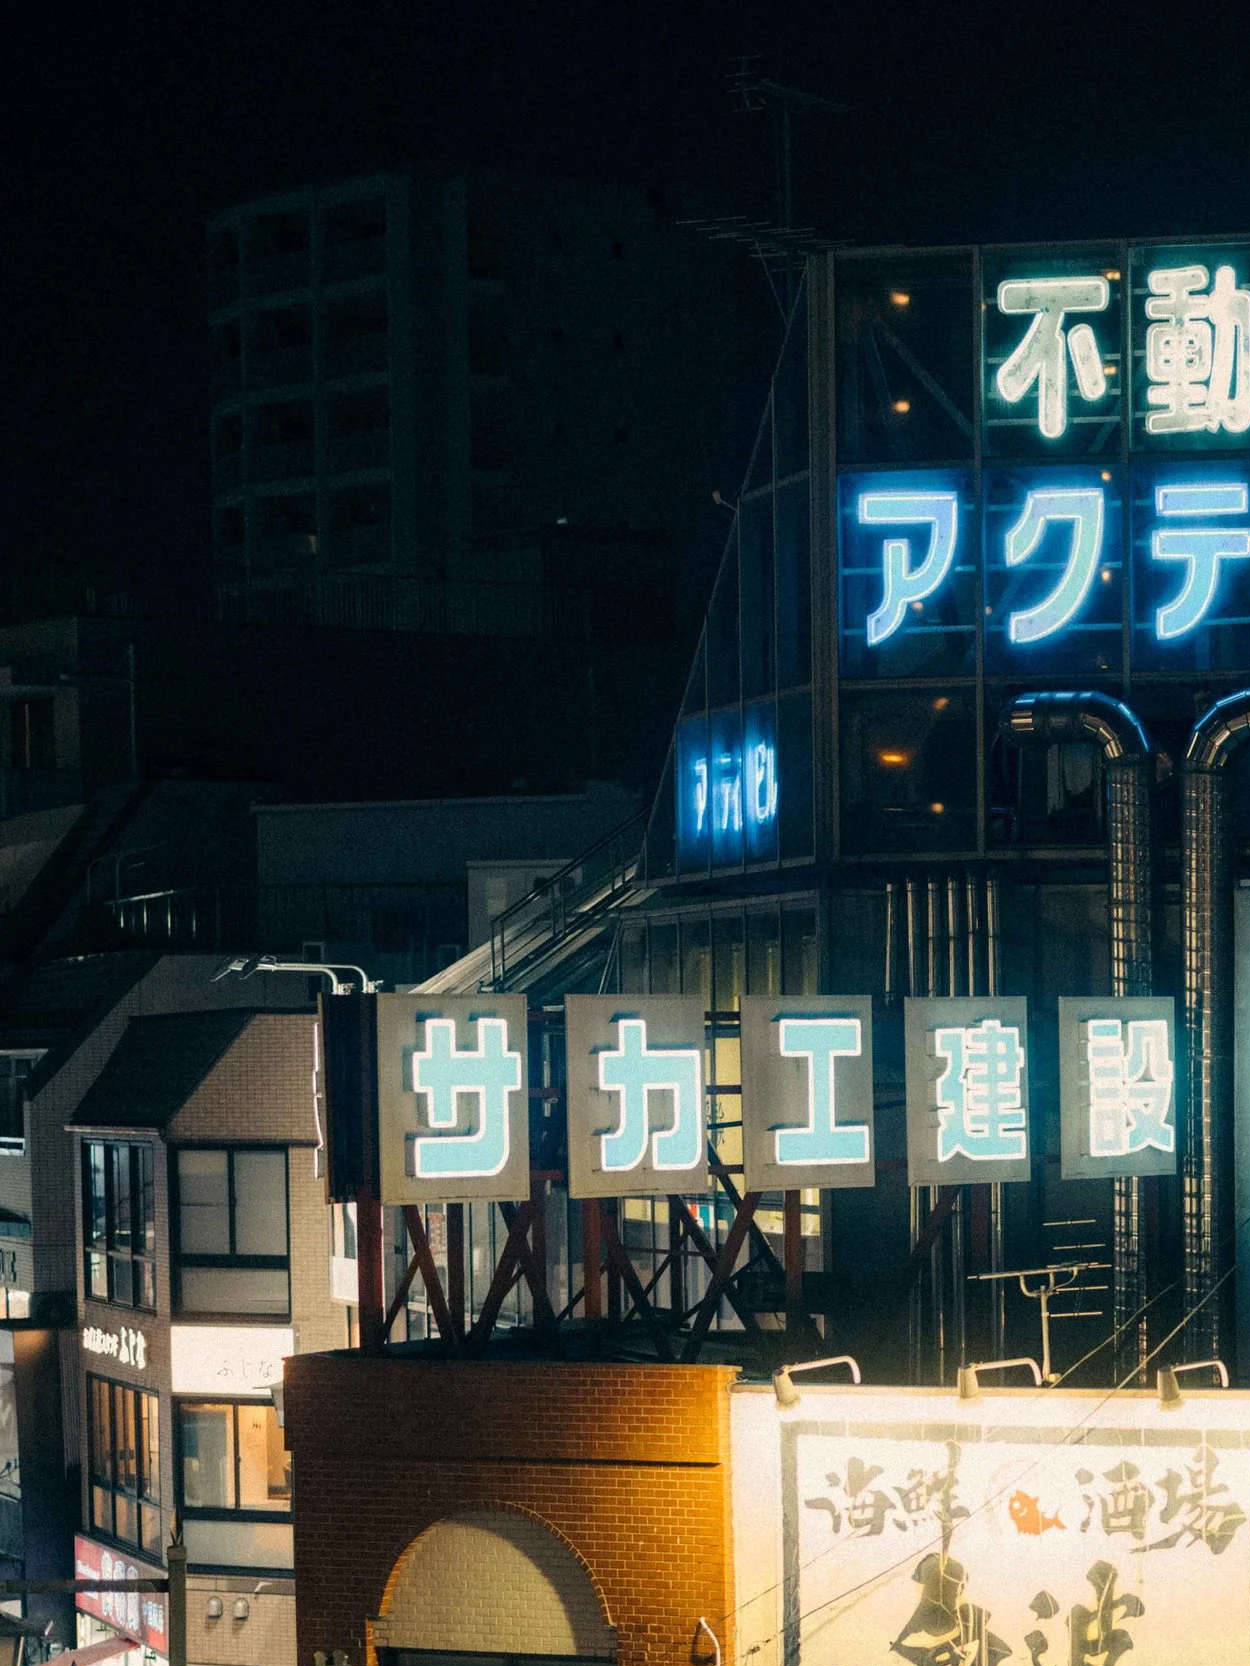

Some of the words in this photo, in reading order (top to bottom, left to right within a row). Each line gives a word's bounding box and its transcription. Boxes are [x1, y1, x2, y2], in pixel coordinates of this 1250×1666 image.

[412, 1017, 1176, 1179] サカエ建設
[805, 1441, 971, 1545] 海鮮
[1073, 1446, 1248, 1555] 酒場
